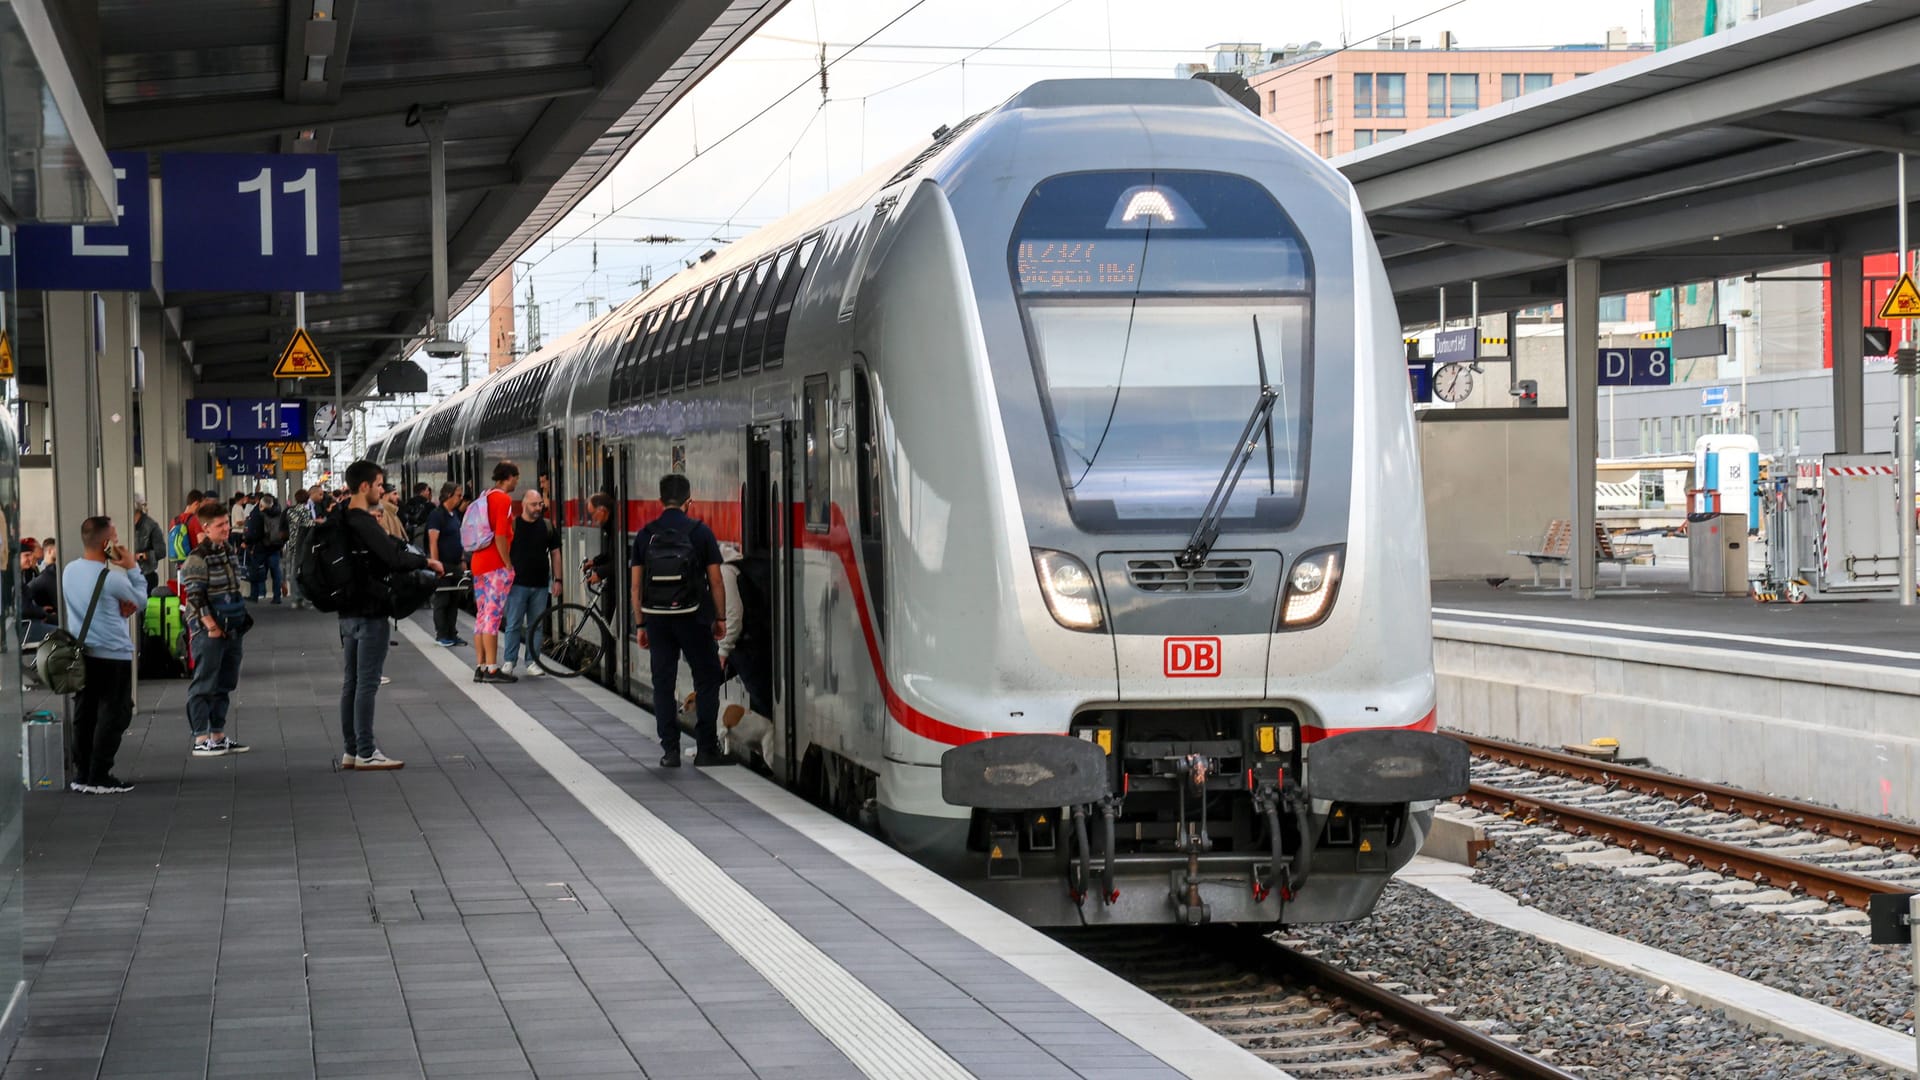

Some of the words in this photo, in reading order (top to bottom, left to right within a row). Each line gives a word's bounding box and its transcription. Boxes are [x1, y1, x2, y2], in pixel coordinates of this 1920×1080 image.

[238, 168, 318, 256] 11
[1018, 263, 1092, 287] Siegen
[1606, 352, 1625, 378] D
[1648, 350, 1666, 377] 8
[201, 403, 222, 430] D
[251, 402, 276, 429] 11
[1171, 643, 1215, 671] DB
